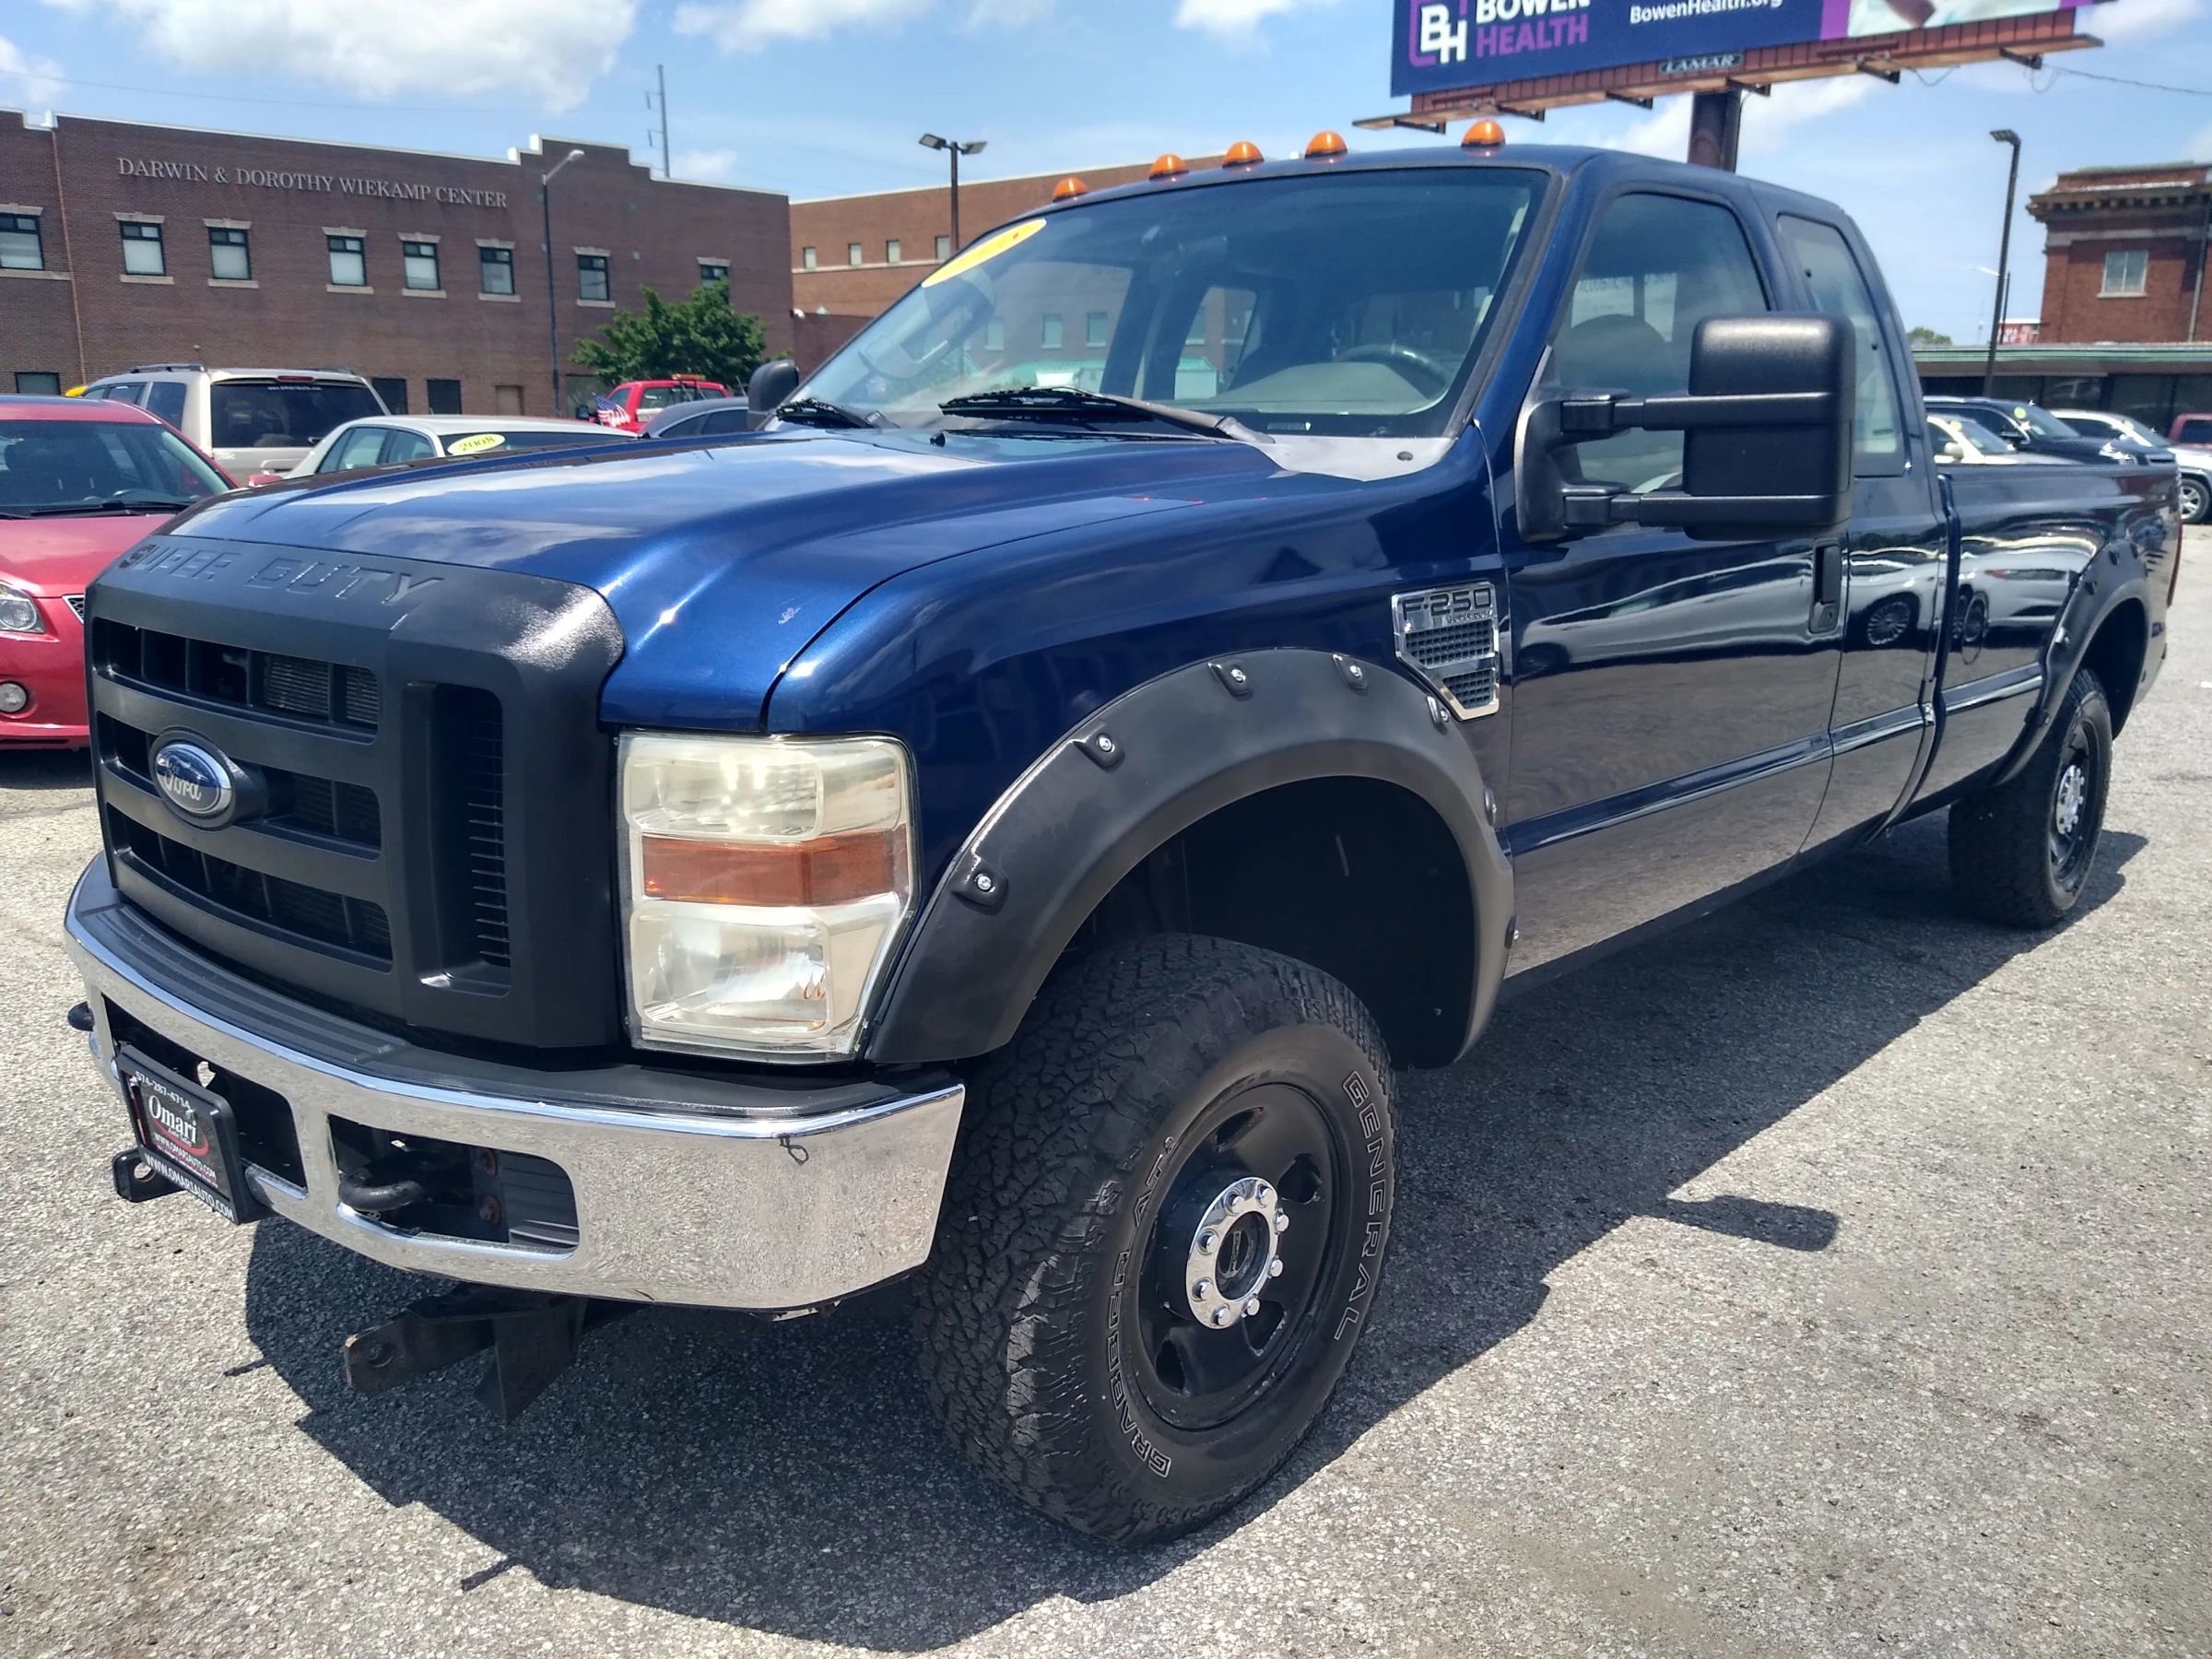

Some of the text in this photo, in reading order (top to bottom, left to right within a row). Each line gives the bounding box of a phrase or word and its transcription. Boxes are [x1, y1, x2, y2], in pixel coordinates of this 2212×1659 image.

[1476, 0, 1592, 24] BOW
[1476, 13, 1589, 59] HEALTH
[117, 158, 507, 208] DARWIN & DOROTHY WIEKAMP CENTER
[148, 1095, 197, 1144] Omari
[144, 1153, 235, 1222] WWW.OMARIAUTO.COM
[1335, 1070, 1385, 1340] GENERAL
[1108, 1249, 1171, 1477] GRABBER
